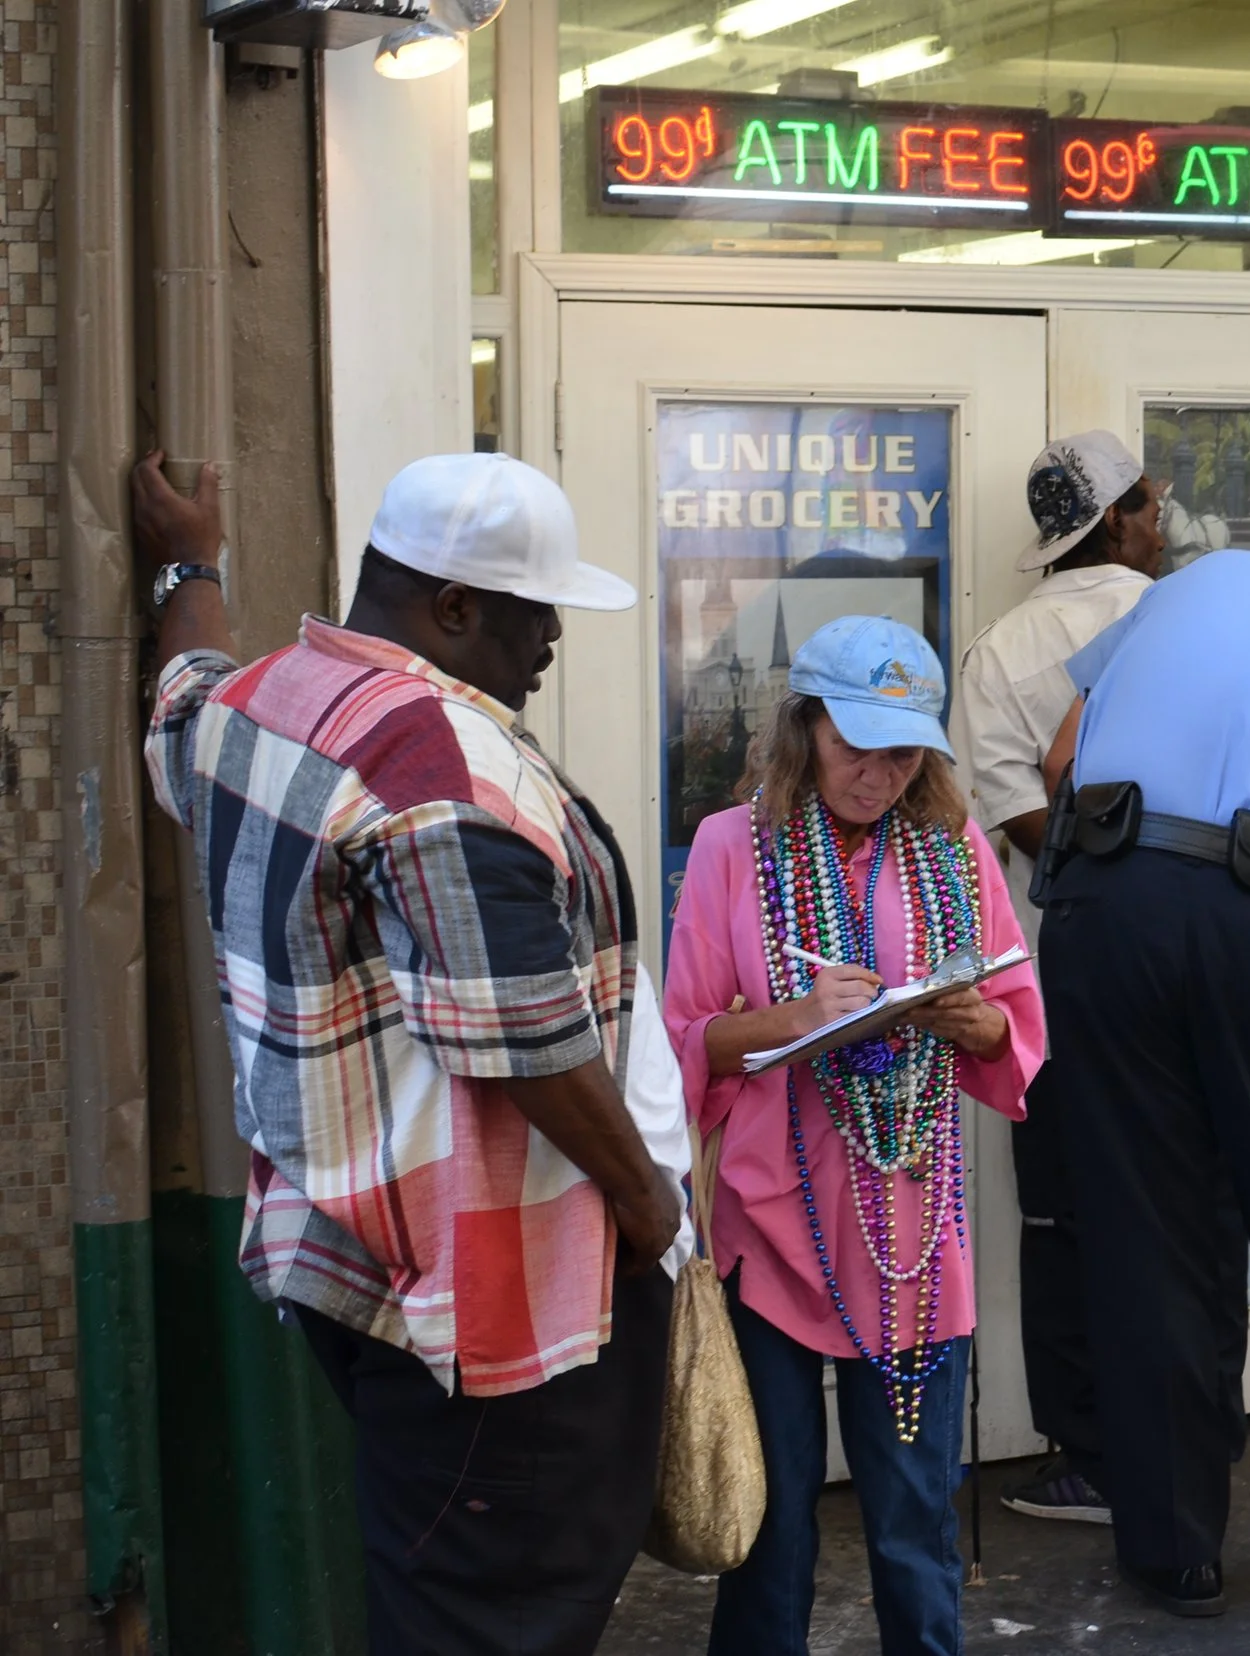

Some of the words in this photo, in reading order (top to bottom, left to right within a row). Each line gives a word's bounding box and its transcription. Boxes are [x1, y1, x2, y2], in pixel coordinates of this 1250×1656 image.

[734, 119, 878, 191] ATM
[897, 126, 1029, 194] FEE
[688, 432, 916, 476] UNIQUE
[662, 488, 943, 529] GROCERY
